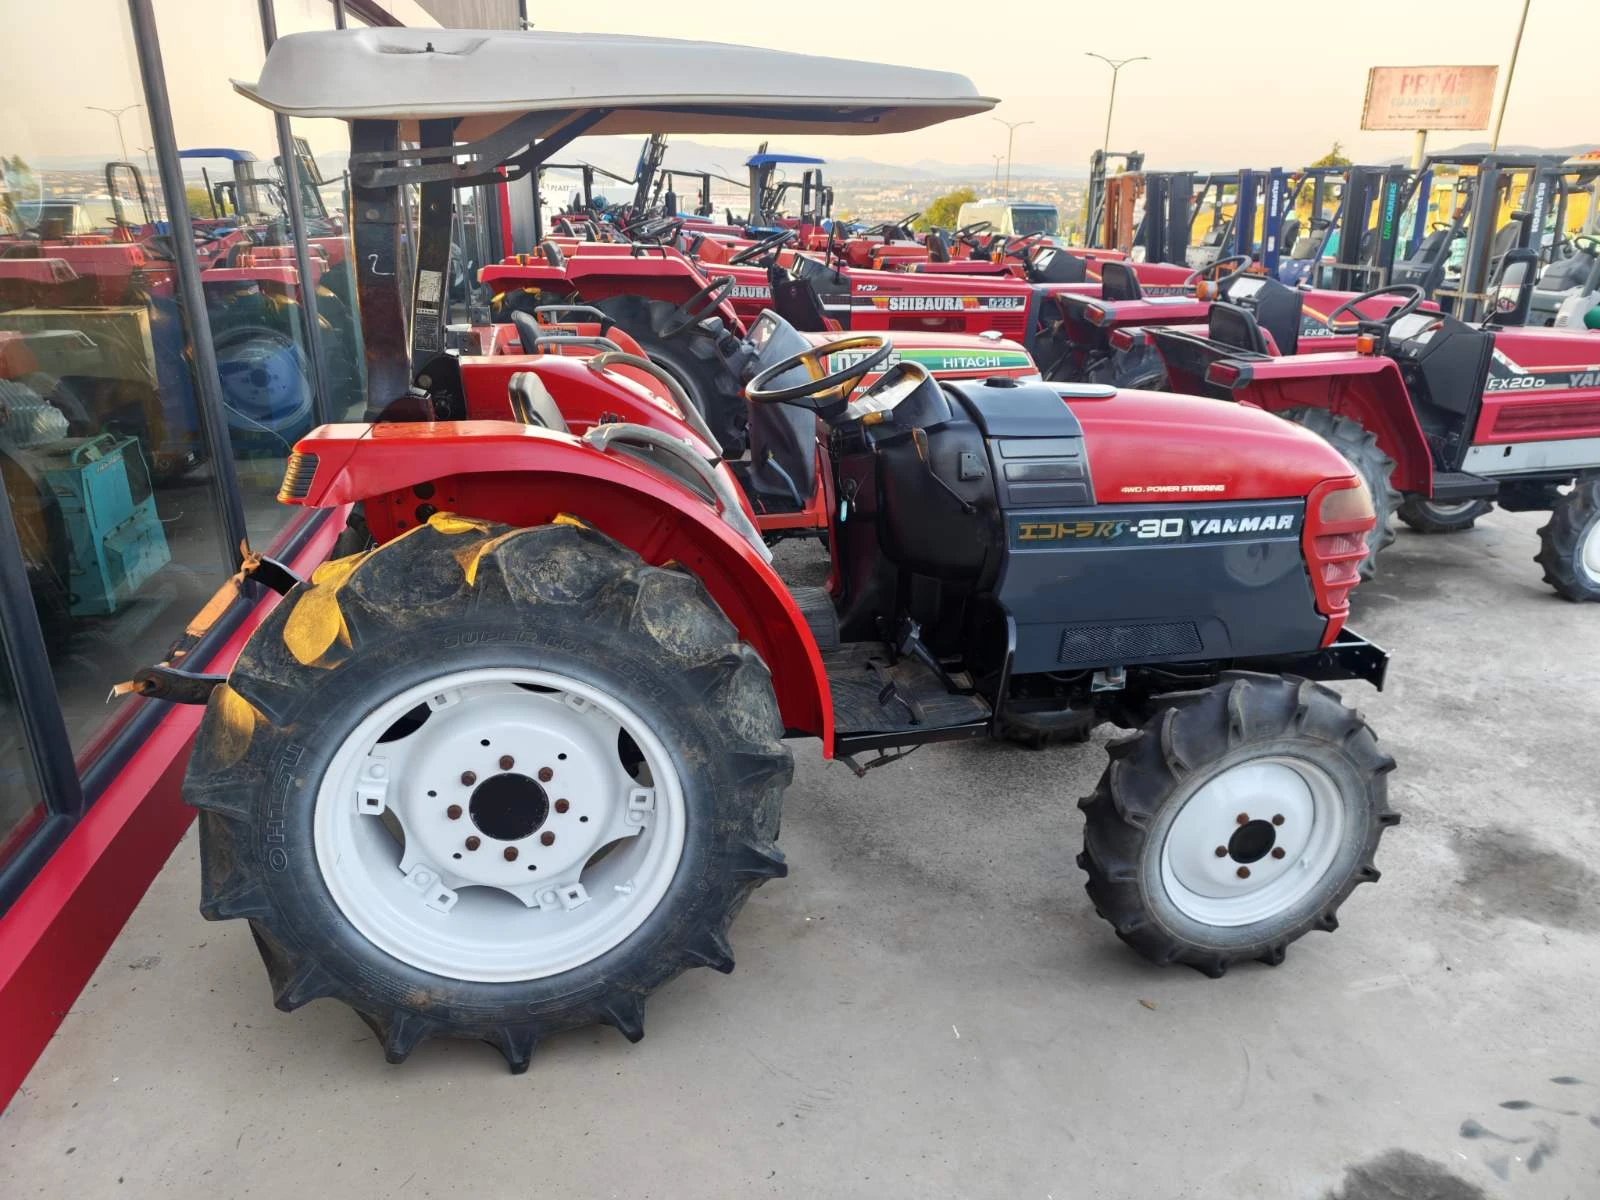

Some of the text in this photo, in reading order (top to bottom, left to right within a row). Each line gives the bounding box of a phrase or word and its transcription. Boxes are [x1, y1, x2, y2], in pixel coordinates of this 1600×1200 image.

[1531, 182, 1546, 233] KOMATSU
[888, 297, 965, 311] SHIBAURA
[943, 356, 1001, 369] HITACHI
[1146, 485, 1180, 493] POWER
[1180, 484, 1225, 492] STEERING
[1190, 514, 1295, 537] YANMAR
[266, 744, 305, 873] OHTSU
